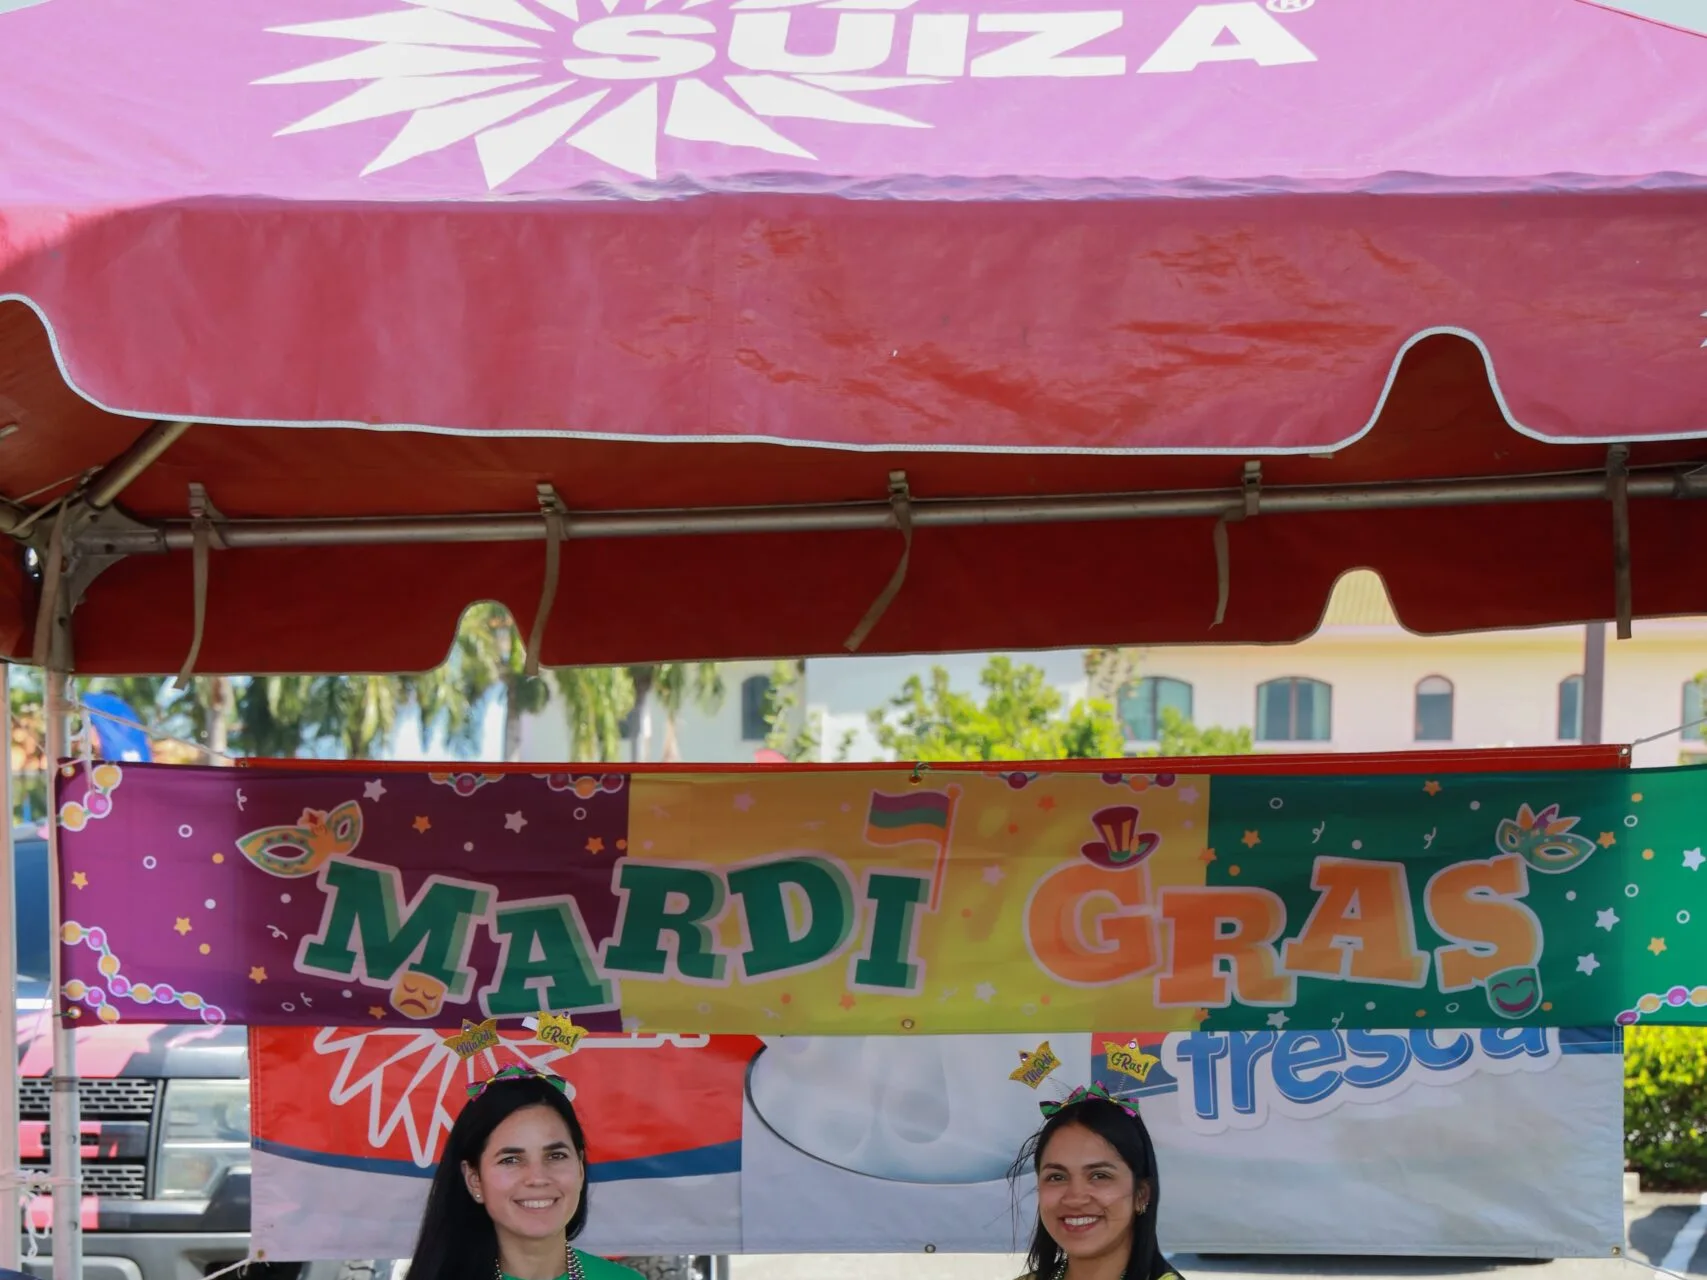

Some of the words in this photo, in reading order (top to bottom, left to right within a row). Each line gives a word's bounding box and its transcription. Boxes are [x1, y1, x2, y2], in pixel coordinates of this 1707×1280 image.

[563, 2, 1317, 79] SUIZA
[297, 852, 928, 1016] MARDI
[1025, 856, 1543, 1007] GRAS
